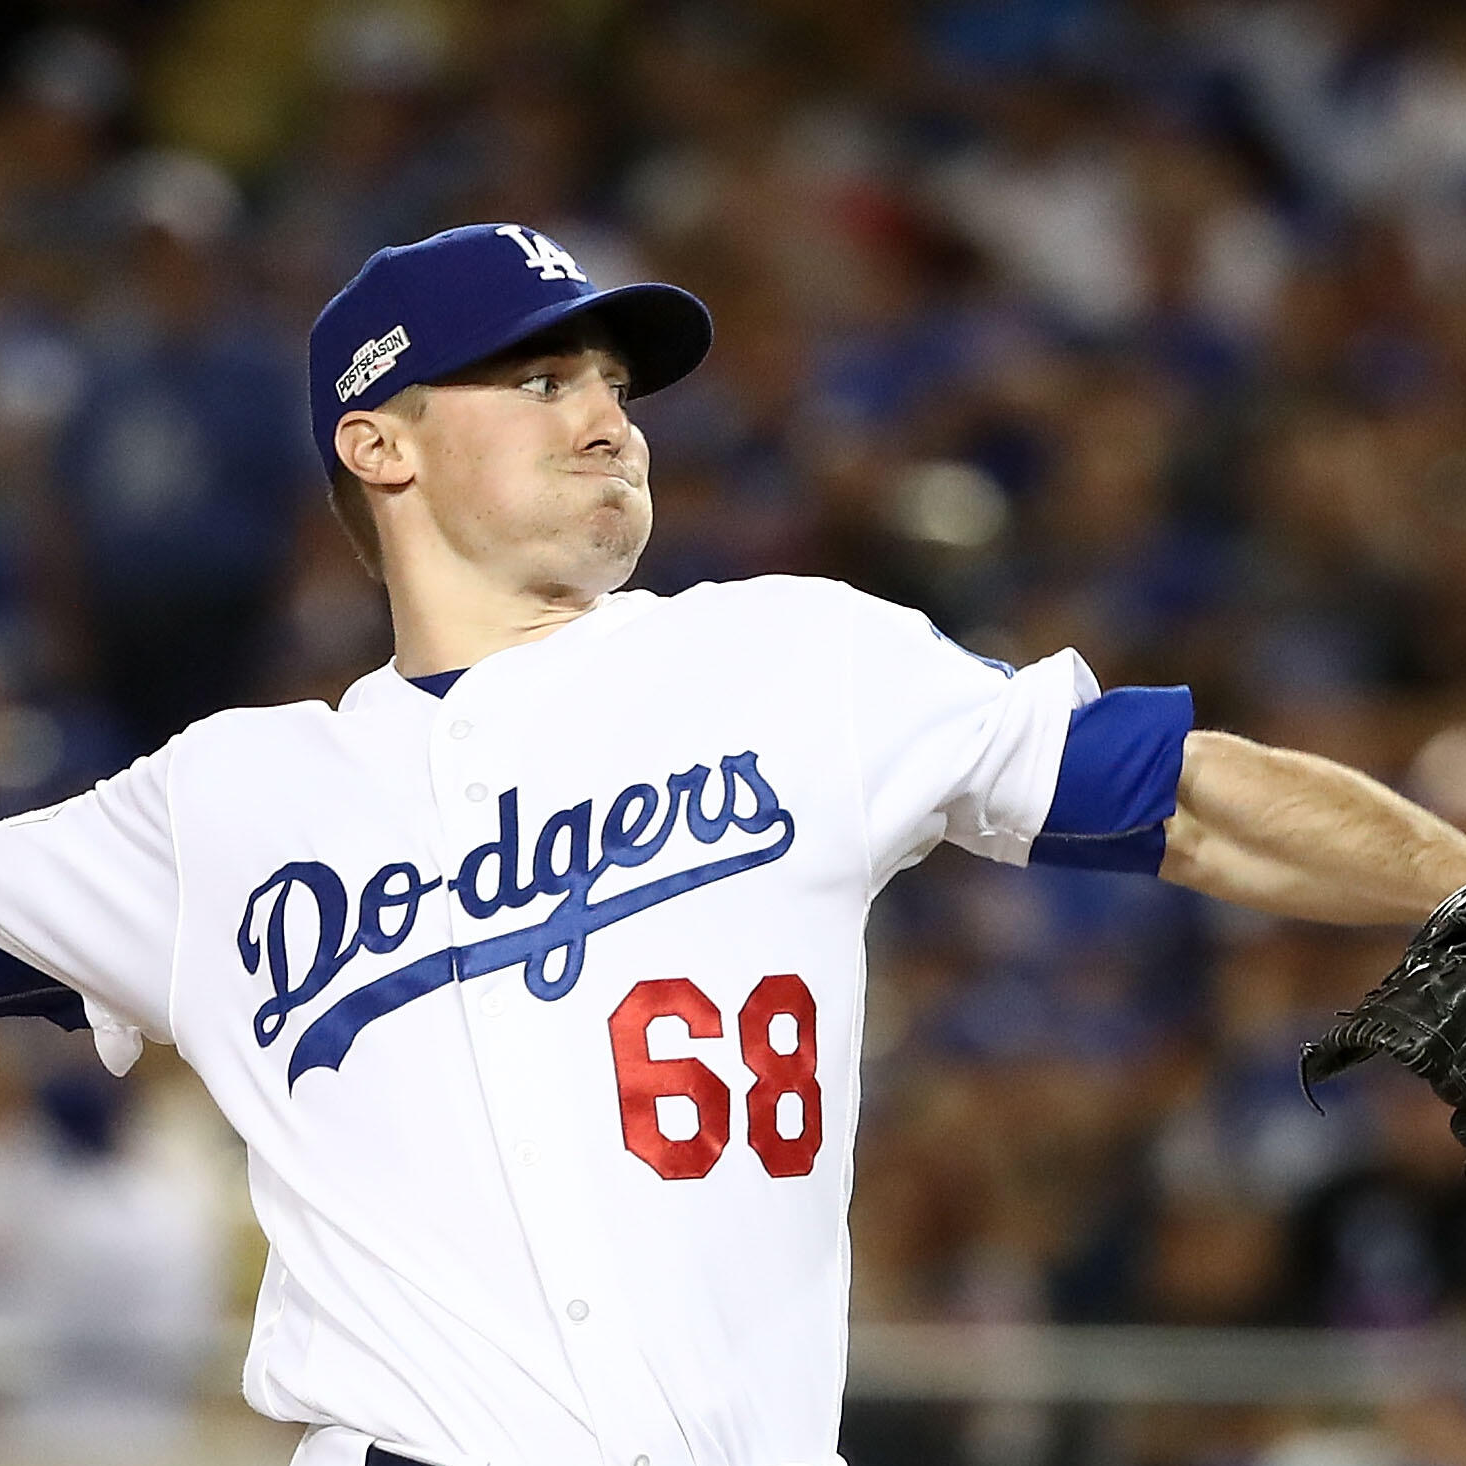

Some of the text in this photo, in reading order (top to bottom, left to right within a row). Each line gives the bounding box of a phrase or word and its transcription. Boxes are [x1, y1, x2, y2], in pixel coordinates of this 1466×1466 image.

[495, 225, 588, 283] LA
[338, 330, 405, 399] POSTSEASON
[237, 750, 795, 1099] Dodgers
[608, 974, 822, 1181] 68
